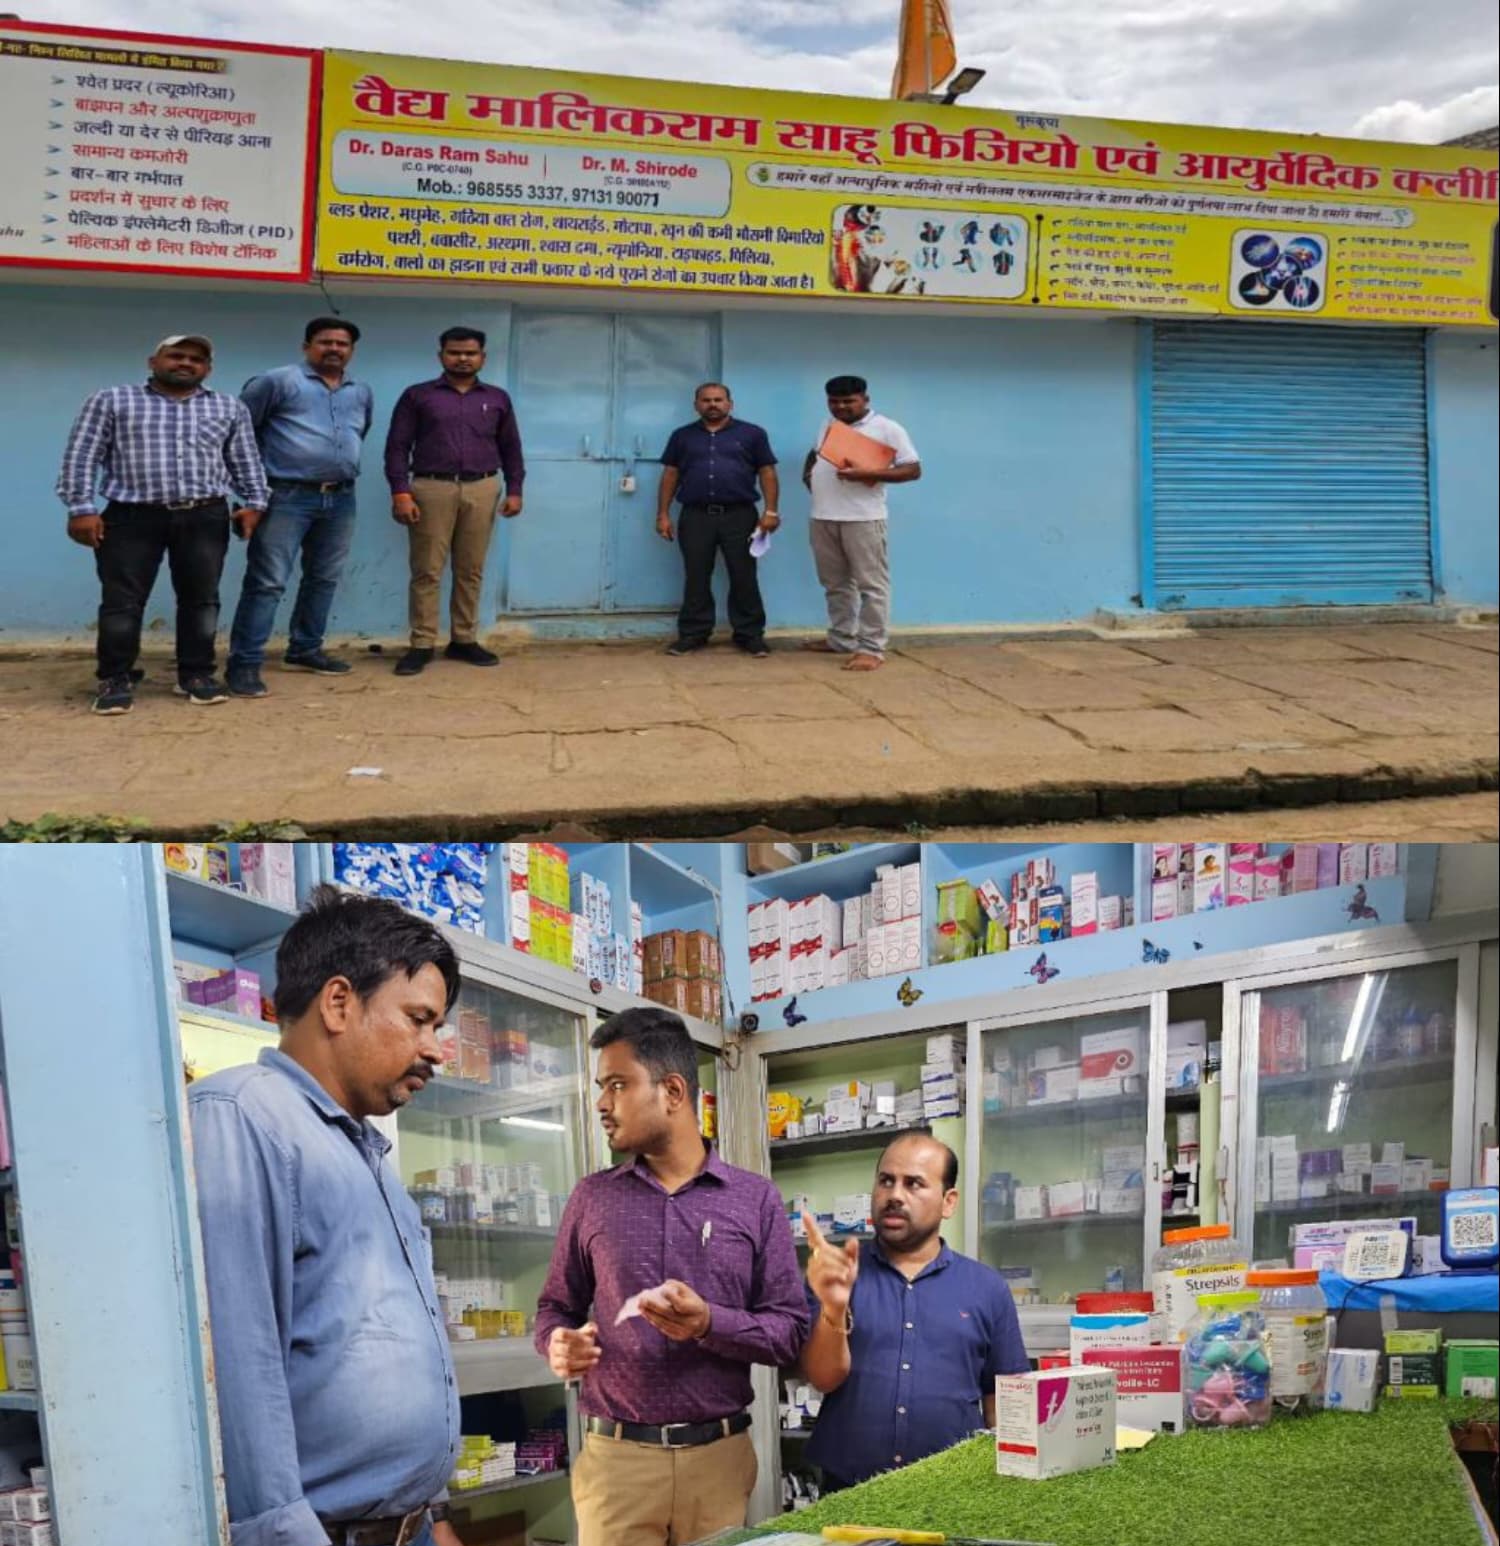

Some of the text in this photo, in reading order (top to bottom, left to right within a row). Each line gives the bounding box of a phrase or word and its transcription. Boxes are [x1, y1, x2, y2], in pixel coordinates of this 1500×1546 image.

[75, 75, 107, 90] श्वेत
[112, 78, 142, 92] प्रदर
[129, 101, 157, 116] और
[74, 119, 112, 136] जल्दी
[118, 124, 134, 137] या
[140, 122, 160, 139] देर
[165, 125, 179, 141] से
[238, 134, 271, 149] आना
[352, 75, 449, 122] वैद्य
[466, 91, 761, 145] मालिकराम
[776, 118, 882, 164] साहू
[892, 121, 1076, 169] फिजियो
[1094, 140, 1161, 179] एवं
[1174, 150, 1379, 194] आयुर्वेदिक
[72, 143, 188, 164] सामान्य कमजोरी
[349, 139, 529, 166] Dr. Daras Ram Sahu
[135, 169, 183, 187] गर्भपात
[582, 156, 698, 178] Dr. M. Shirode
[69, 189, 116, 204] प्रदर्शन
[182, 194, 197, 210] के
[202, 195, 229, 213] लिए
[417, 178, 462, 195] Mob.:
[467, 181, 523, 199] 968555
[571, 187, 612, 204] 97131
[329, 202, 355, 217] ब्लड
[450, 208, 489, 225] गठिया
[136, 240, 152, 252] के
[157, 239, 184, 254] लिए
[190, 240, 228, 257] विशेष
[428, 255, 445, 271] का
[489, 256, 506, 272] एवं
[579, 261, 591, 278] के
[739, 270, 766, 287] किया
[771, 275, 798, 289] जाता
[1185, 1275, 1240, 1292] Strepsils
